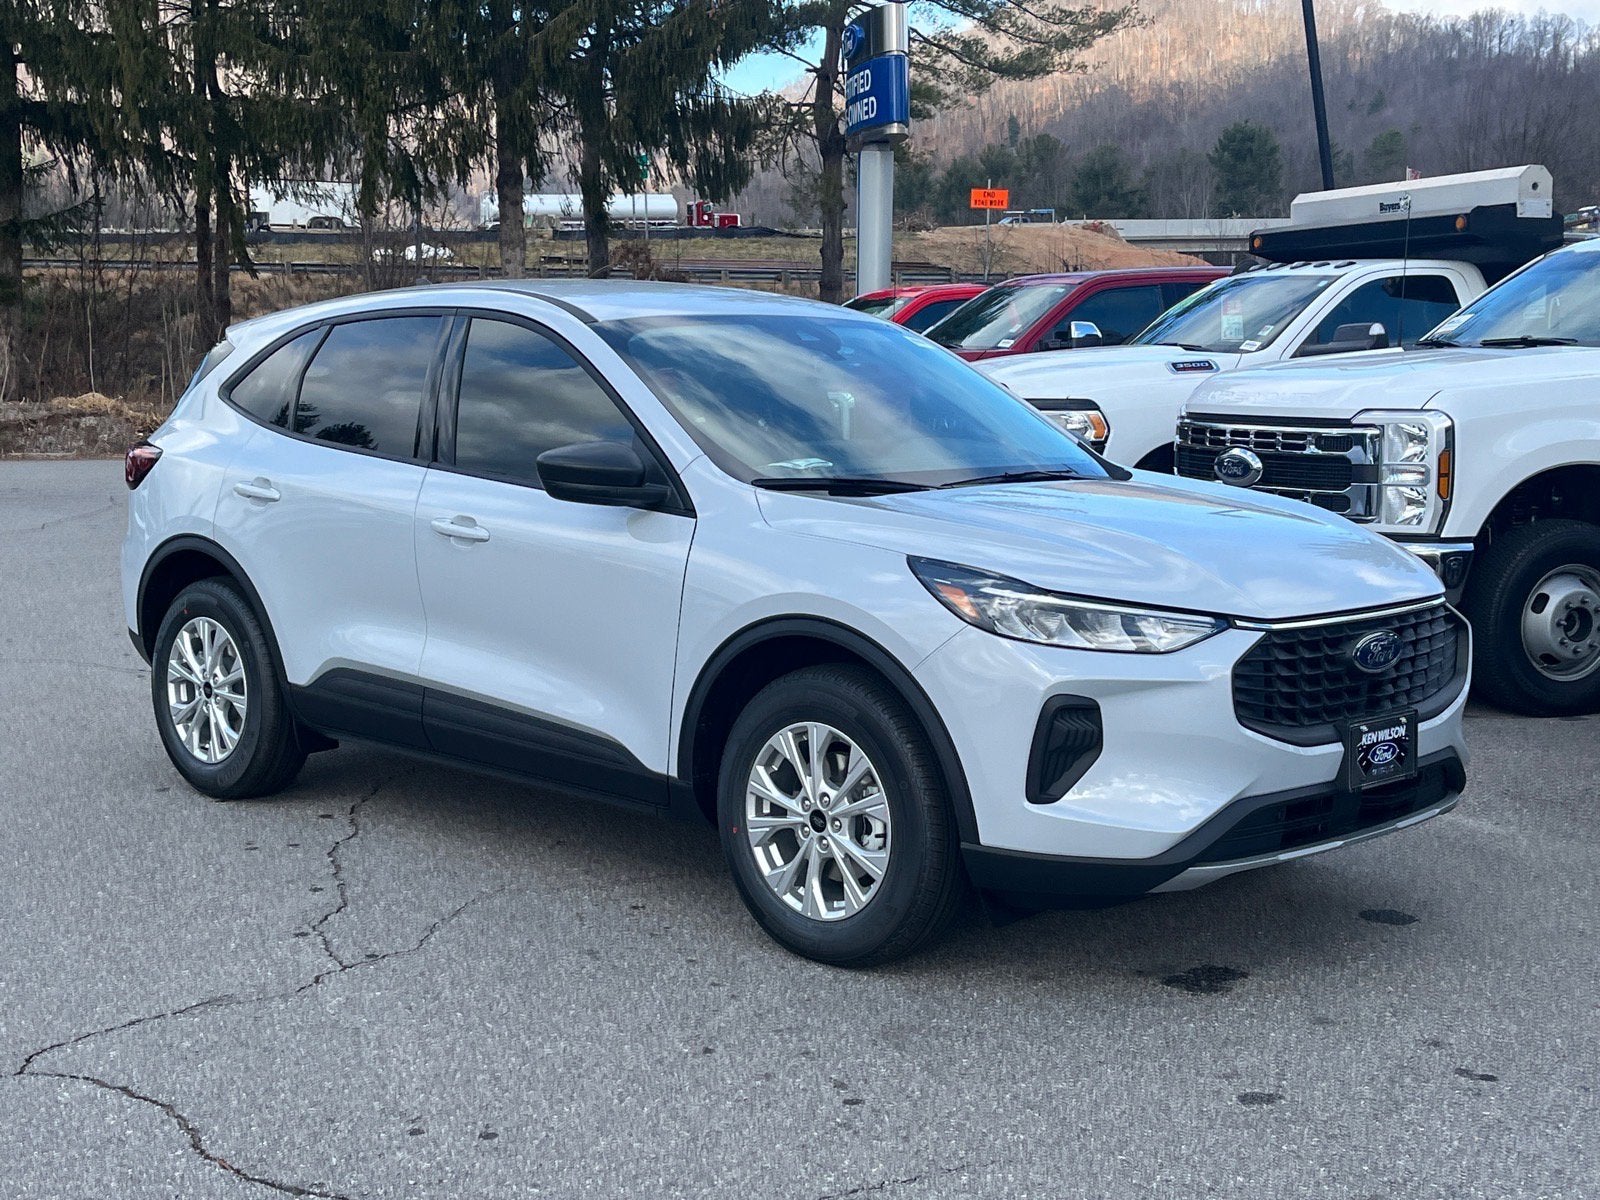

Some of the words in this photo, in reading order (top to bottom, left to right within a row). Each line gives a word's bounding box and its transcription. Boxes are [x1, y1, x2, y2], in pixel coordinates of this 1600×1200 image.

[1221, 458, 1244, 476] Ford
[1366, 640, 1395, 665] Ford
[1361, 731, 1378, 746] KEN
[1377, 725, 1407, 742] WILSON
[1373, 744, 1394, 762] Ford
